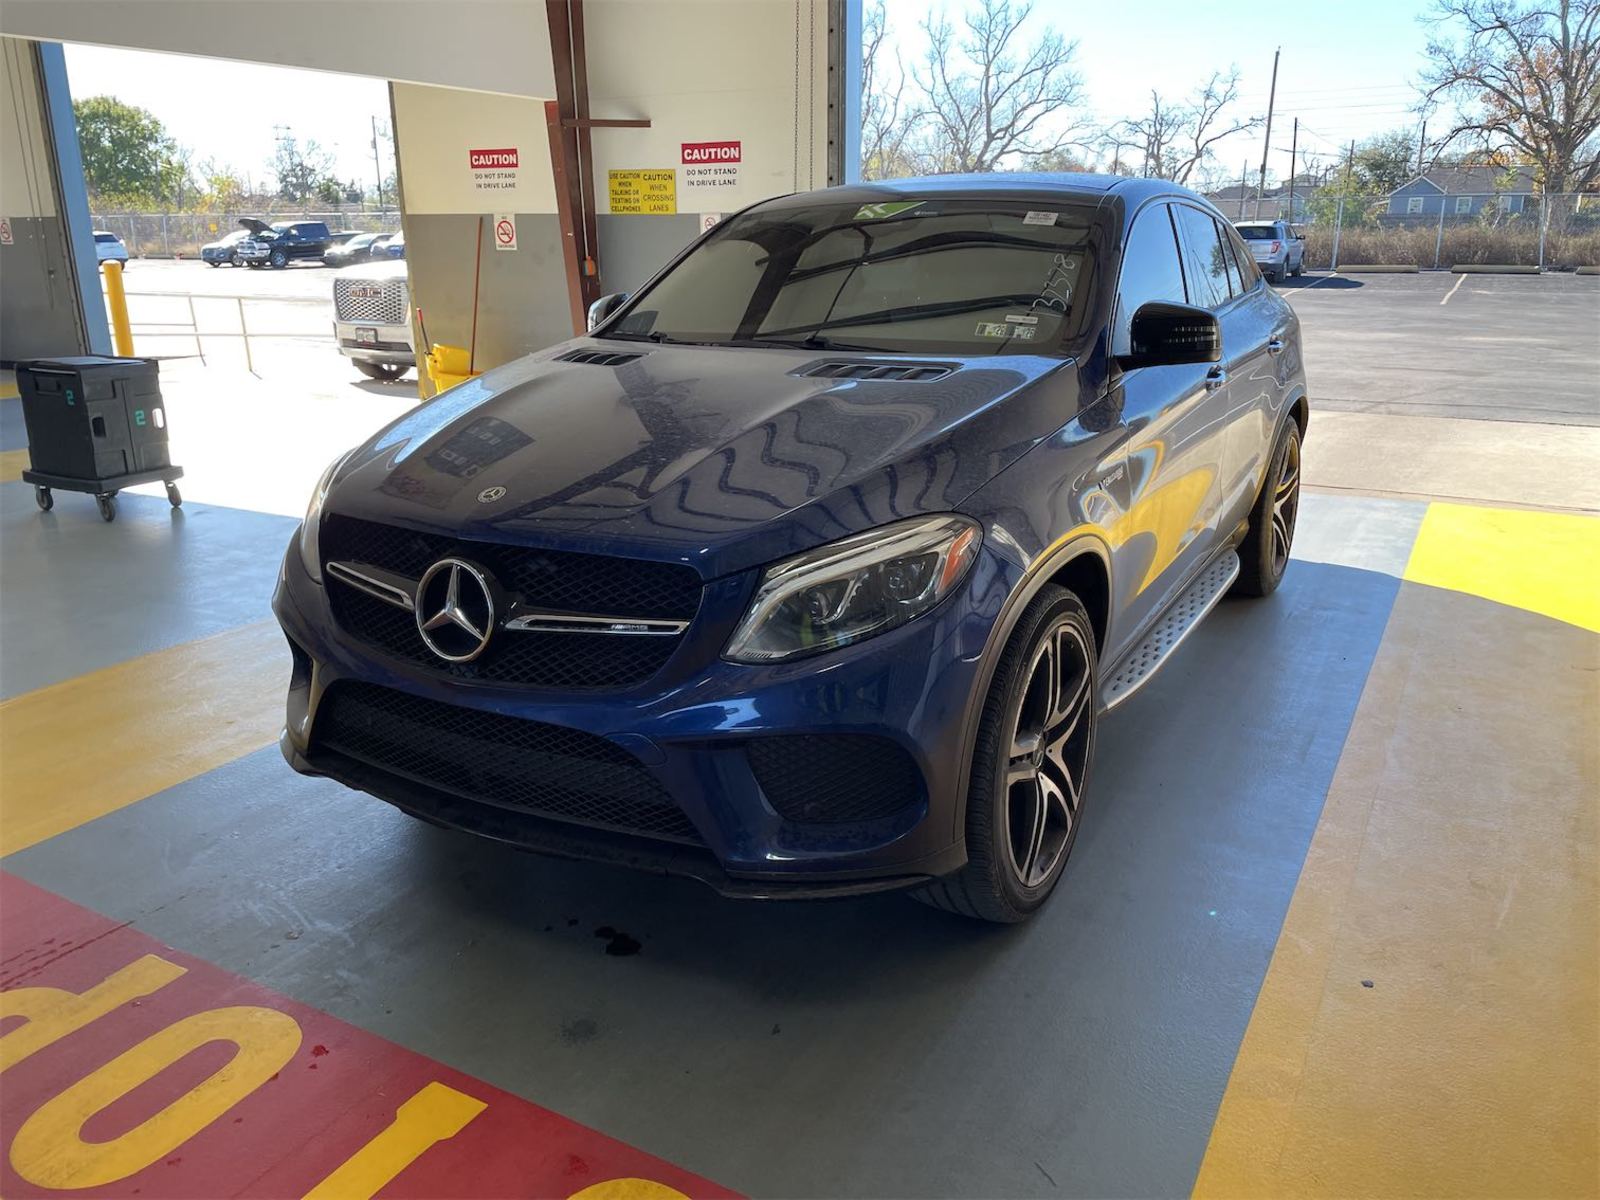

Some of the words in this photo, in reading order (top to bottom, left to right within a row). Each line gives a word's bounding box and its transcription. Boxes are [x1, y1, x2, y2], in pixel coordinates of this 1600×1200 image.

[472, 154, 517, 165] CAUTION
[684, 147, 739, 160] CAUTION
[649, 204, 669, 212] LANES
[65, 389, 76, 406] 2
[135, 410, 146, 425] 2
